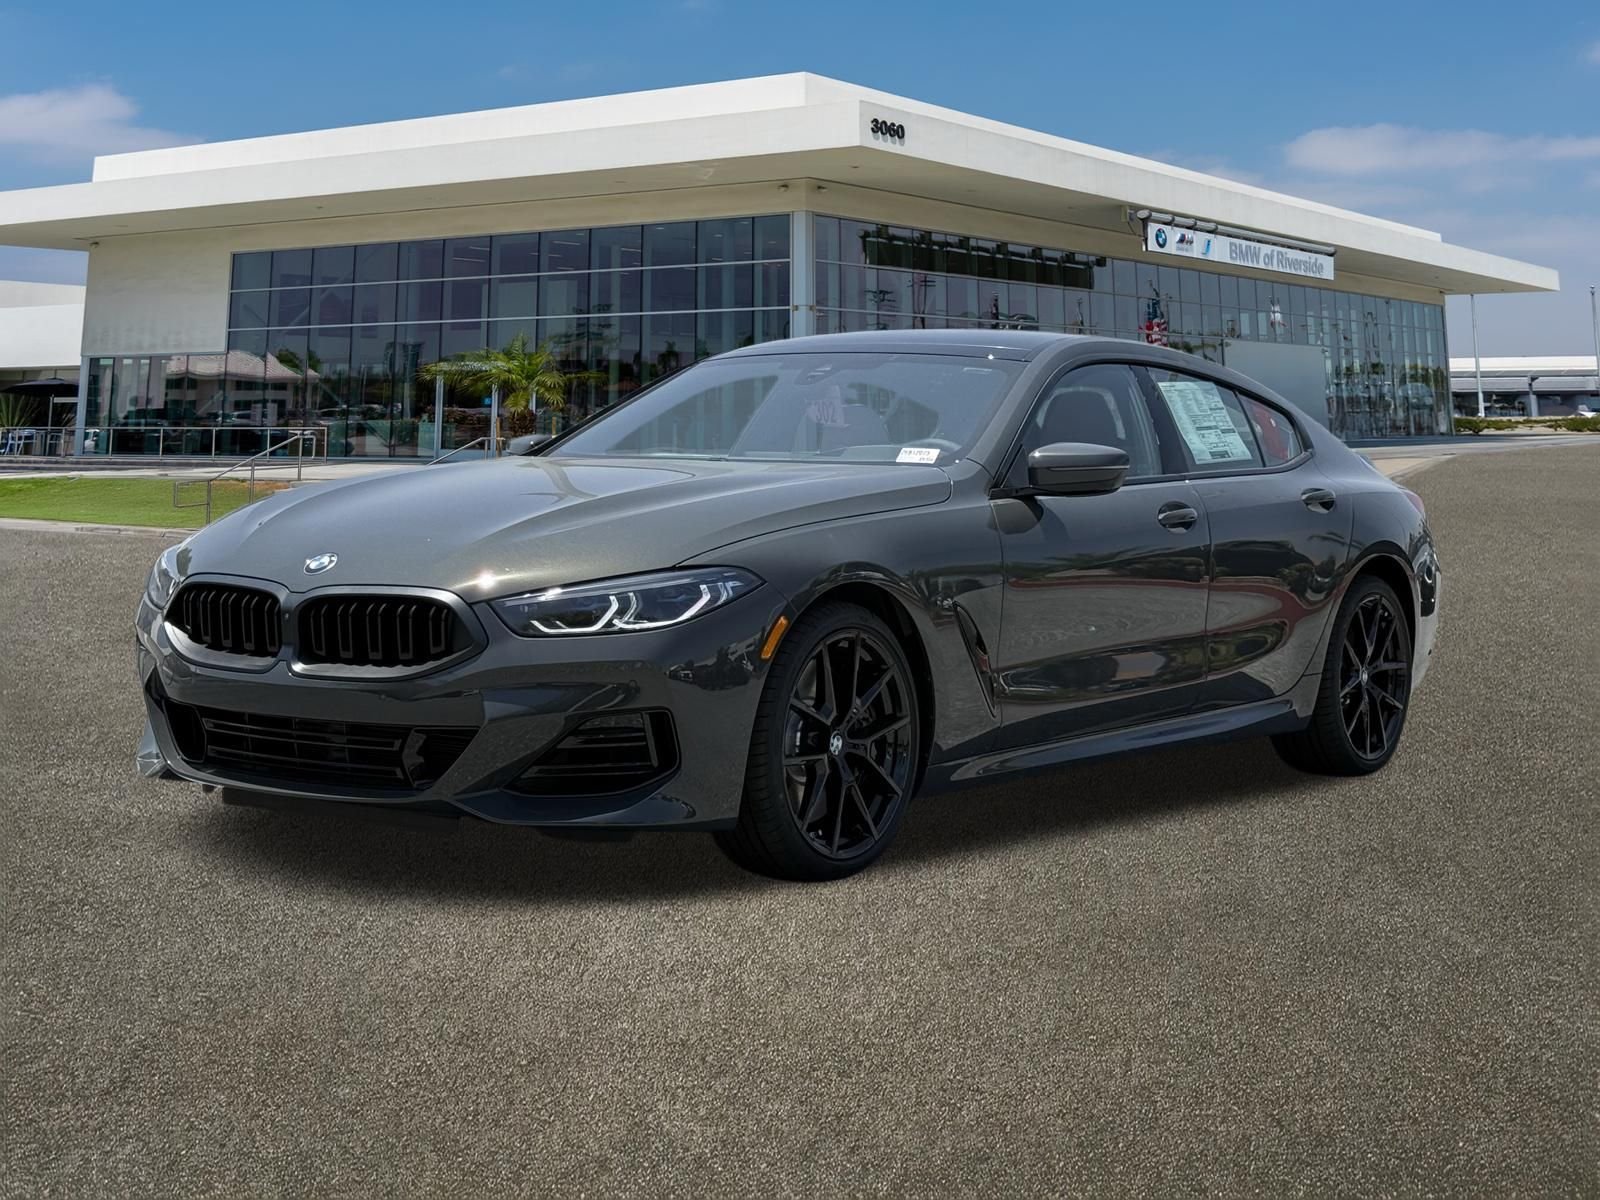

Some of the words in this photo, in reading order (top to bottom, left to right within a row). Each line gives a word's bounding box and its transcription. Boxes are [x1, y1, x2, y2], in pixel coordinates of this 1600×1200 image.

[871, 118, 905, 139] 3060
[1229, 241, 1261, 265] BMW
[1263, 249, 1275, 268] of
[1276, 250, 1324, 275] Riverside
